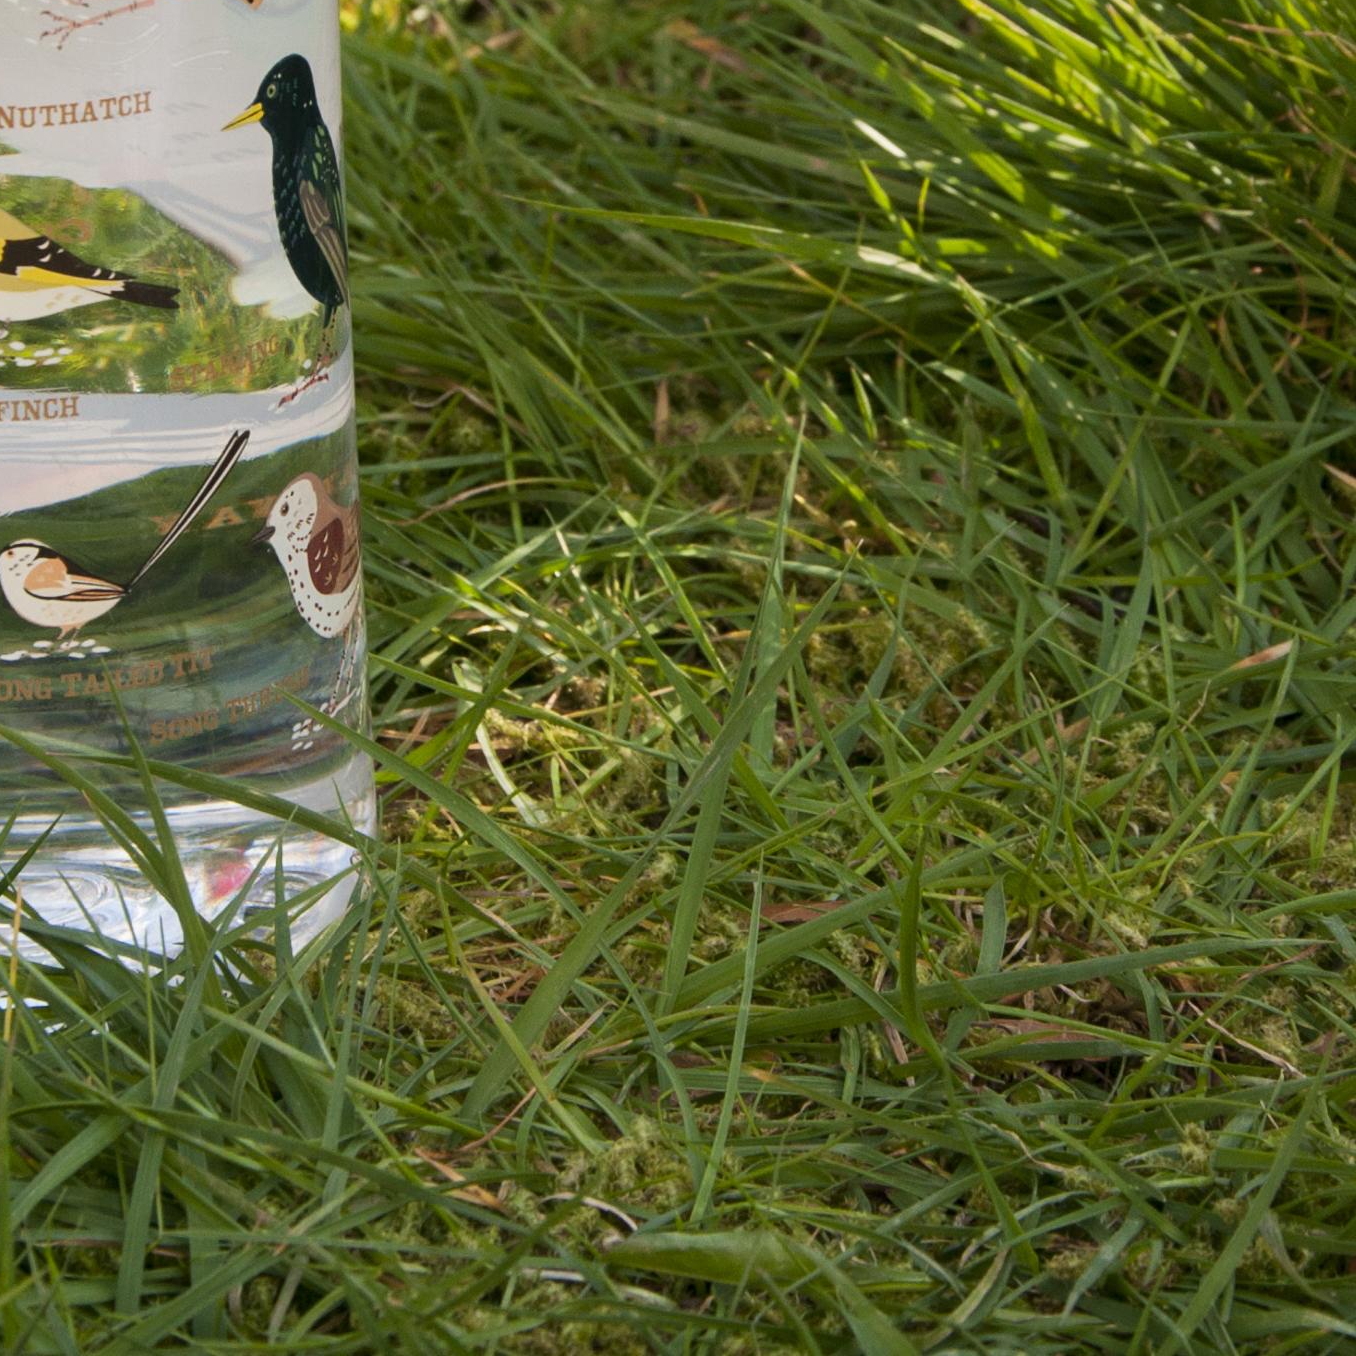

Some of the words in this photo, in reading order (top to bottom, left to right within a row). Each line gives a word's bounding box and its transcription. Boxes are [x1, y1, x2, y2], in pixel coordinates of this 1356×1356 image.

[169, 332, 280, 392] STARLING
[60, 661, 165, 698] TAILED
[169, 646, 216, 678] TIT
[150, 706, 220, 745] SONG
